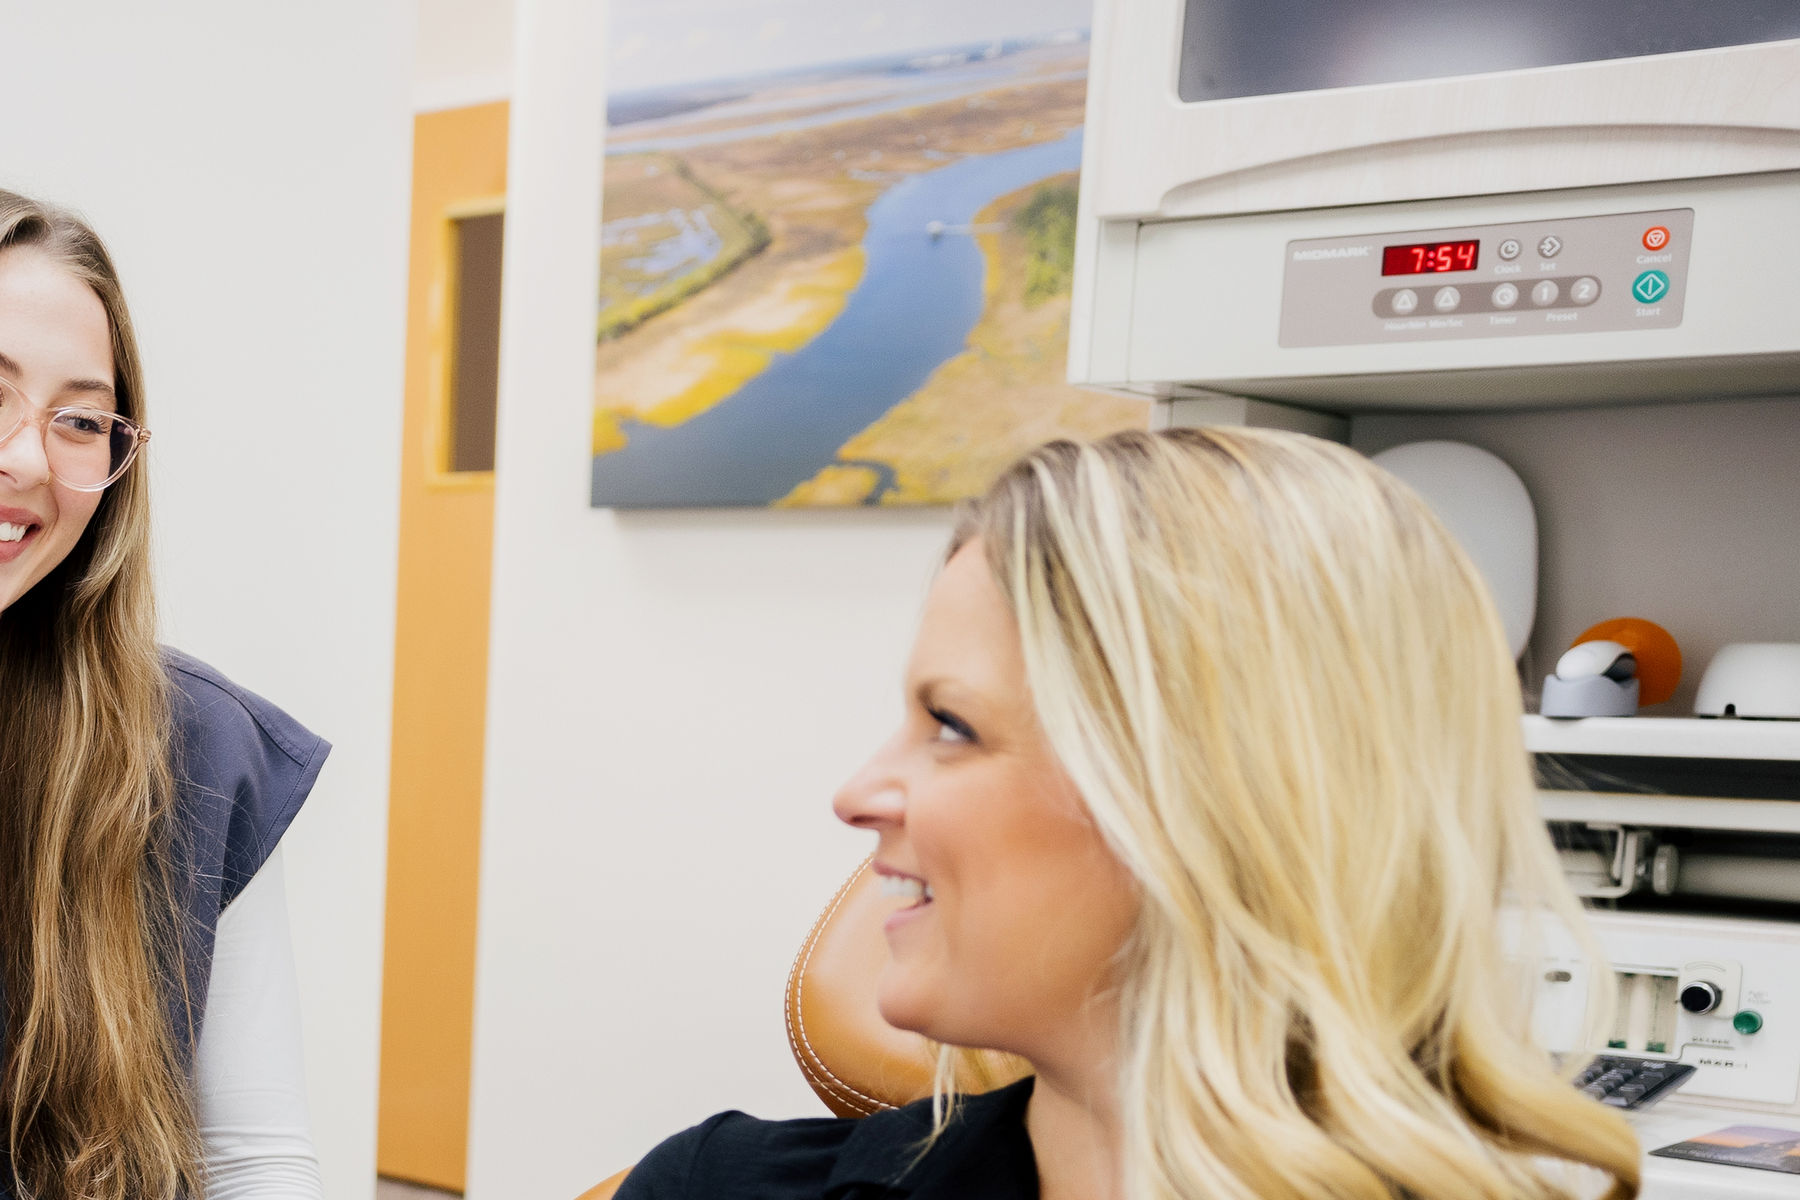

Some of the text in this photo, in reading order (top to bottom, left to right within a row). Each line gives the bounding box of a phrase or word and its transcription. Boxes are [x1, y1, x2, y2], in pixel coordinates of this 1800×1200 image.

[1411, 244, 1475, 272] 7:54
[1636, 253, 1672, 265] Cancel
[1578, 285, 1591, 299] 2
[1545, 311, 1578, 322] Preset
